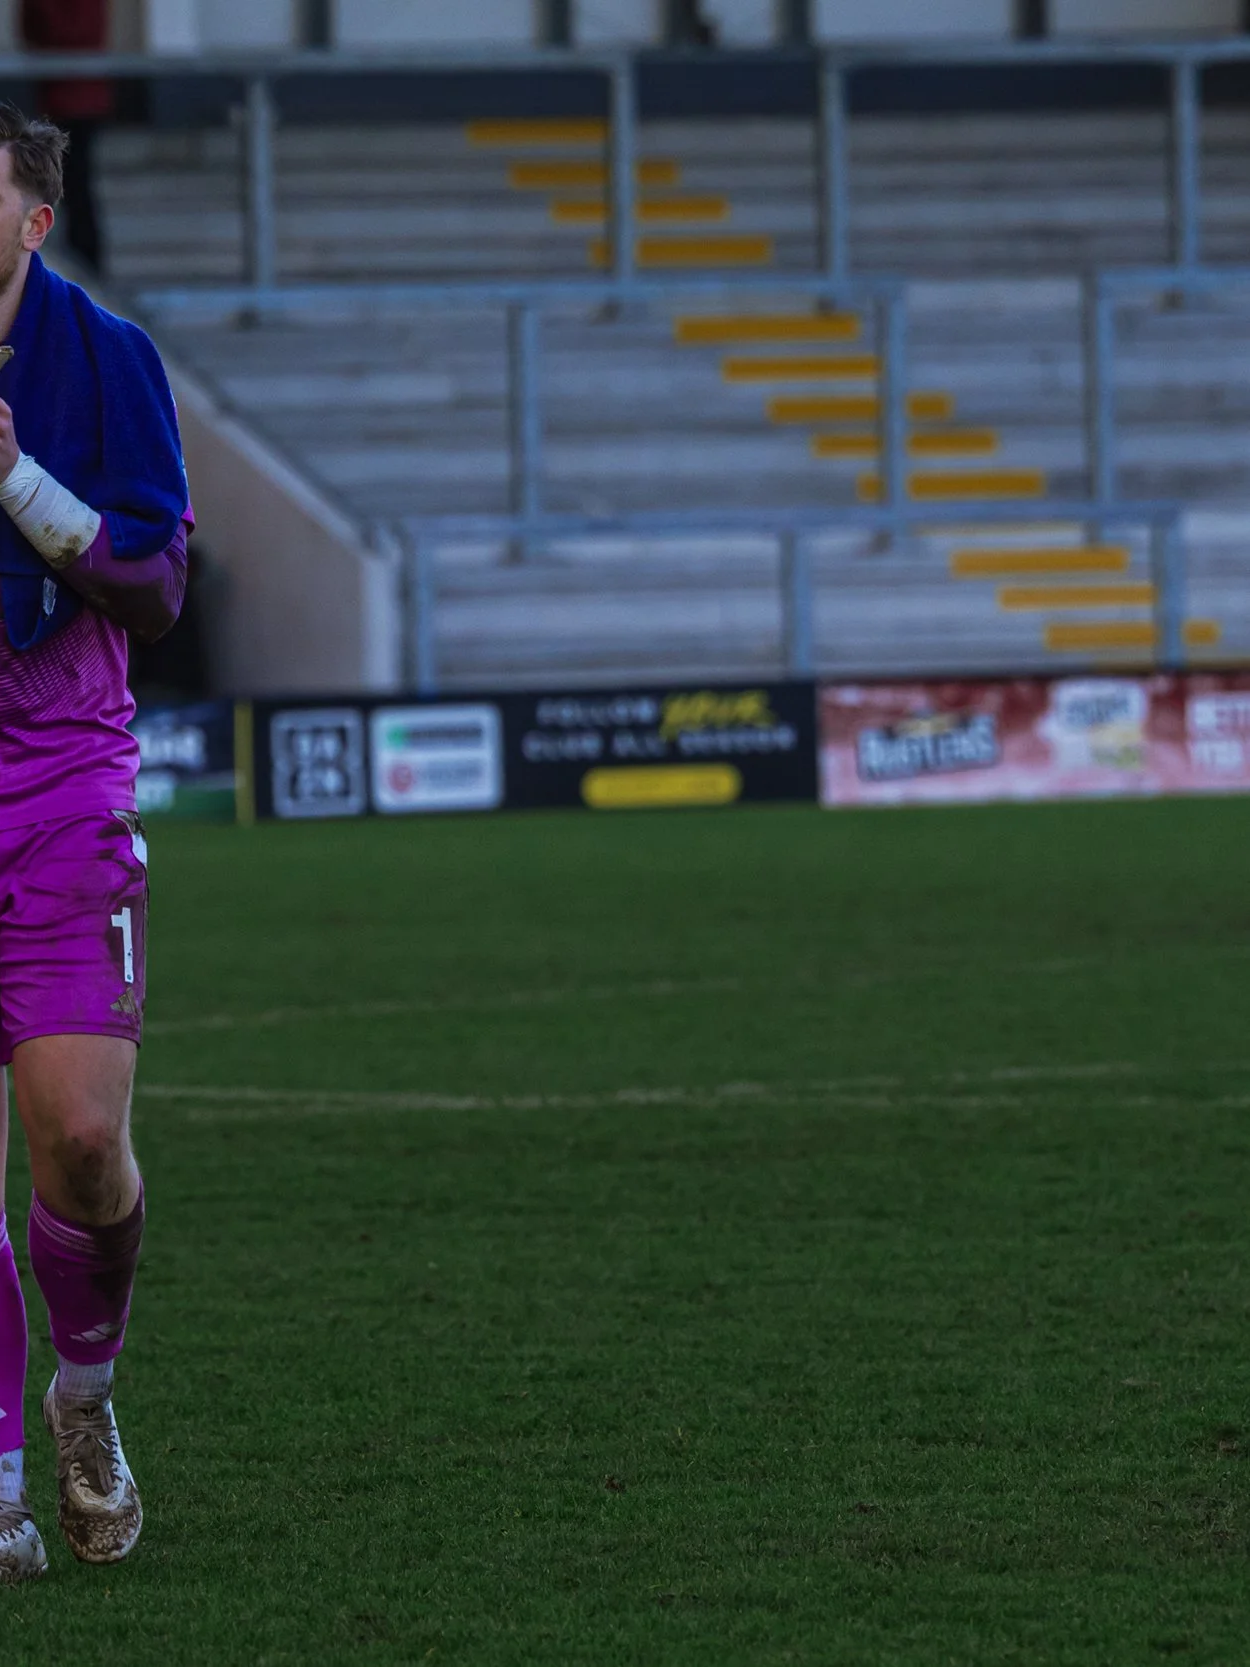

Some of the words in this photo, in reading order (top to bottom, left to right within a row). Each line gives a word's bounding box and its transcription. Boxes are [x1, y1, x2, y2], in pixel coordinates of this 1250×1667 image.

[536, 696, 657, 727] FOLLOW
[522, 731, 604, 762] CLUB
[111, 907, 134, 984] 1
